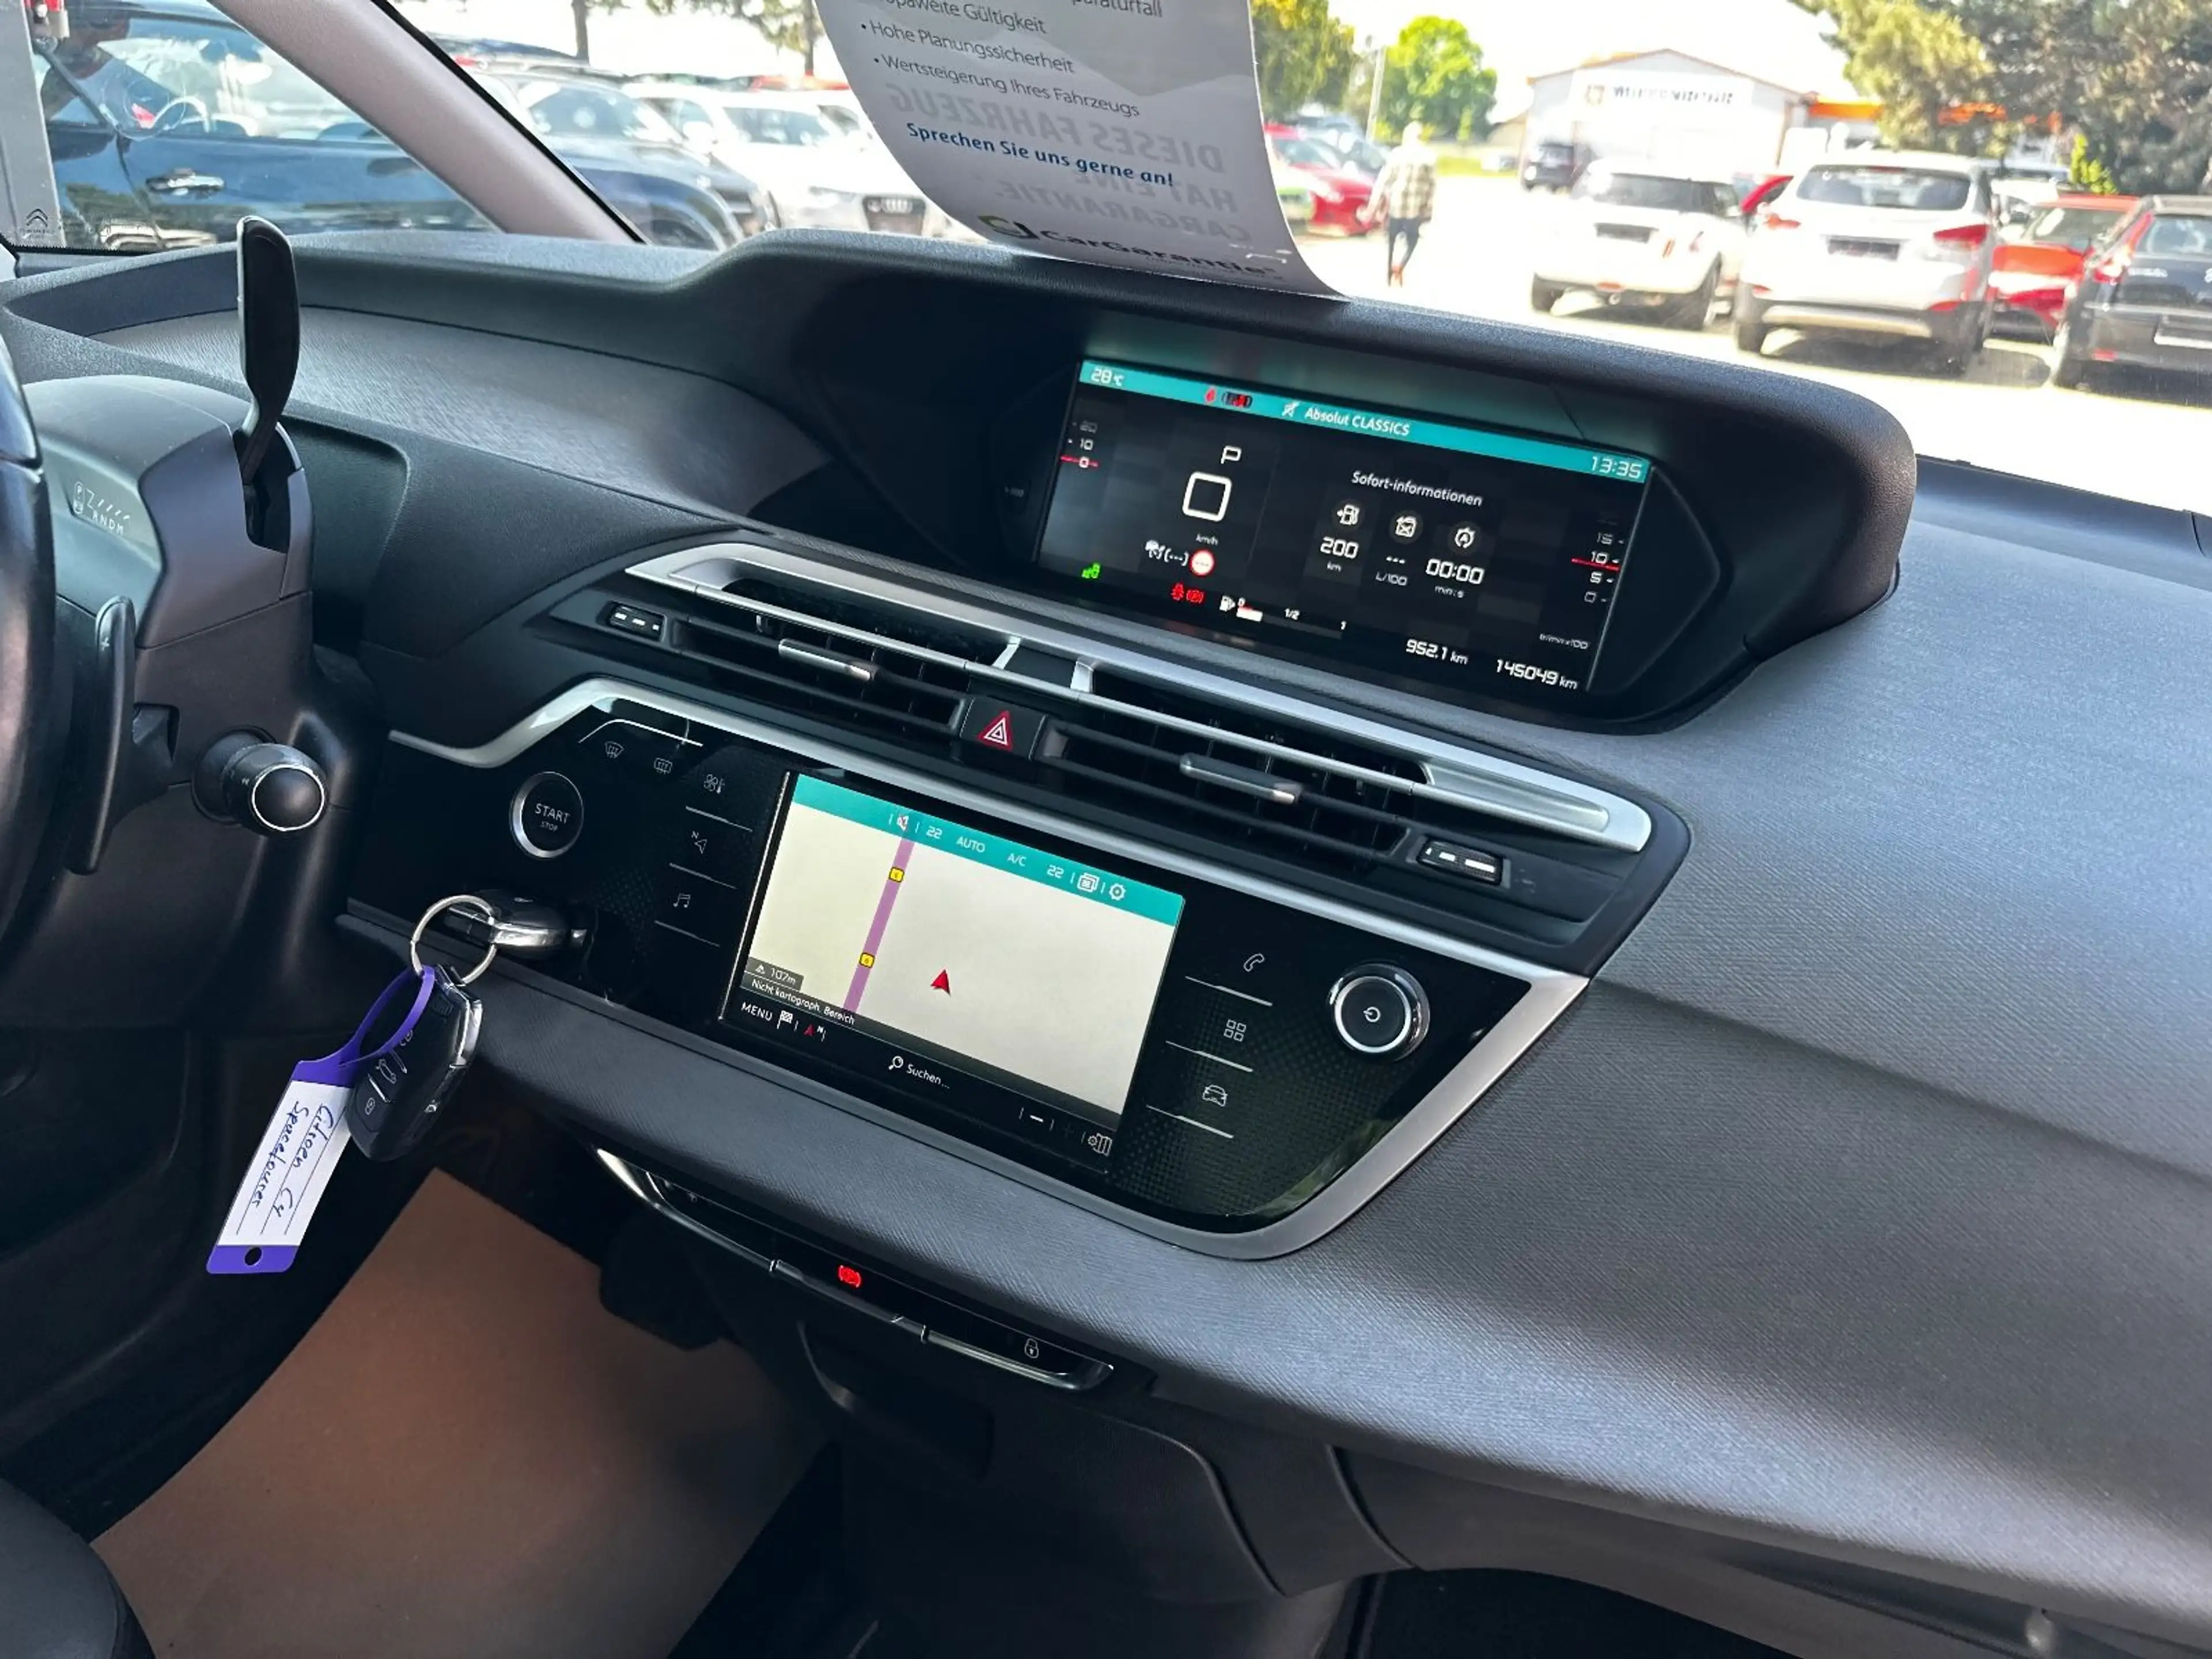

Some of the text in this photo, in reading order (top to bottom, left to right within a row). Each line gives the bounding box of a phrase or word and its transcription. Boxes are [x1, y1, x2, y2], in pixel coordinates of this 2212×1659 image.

[963, 3, 1047, 34] Gültigkeit
[870, 20, 1074, 73] Hohe Planungssicherheit
[881, 54, 1140, 118] Wertsteigerung Ihres Fahrzeugs
[907, 122, 1173, 187] Sprechen Sie uns gerne an!
[1304, 407, 1410, 436] Absolut CLASSICS
[1080, 438, 1094, 451] 10
[1221, 445, 1242, 464] P
[1591, 455, 1642, 479] 13:35
[1351, 470, 1483, 507] Sofort-informationen
[1320, 536, 1359, 559] 200
[1591, 551, 1609, 565] 10
[1327, 560, 1342, 573] km
[1425, 558, 1485, 585] 00:00
[1589, 571, 1603, 584] 5
[1584, 591, 1597, 604] 0
[1284, 608, 1300, 621] 1/2
[1406, 638, 1469, 665] 952.1 km
[1496, 658, 1578, 690] 145049 km
[535, 802, 571, 824] START
[926, 825, 943, 839] 22
[956, 836, 986, 853] AUTO
[1007, 853, 1027, 867] A/C
[1046, 864, 1065, 879] 22
[741, 1001, 773, 1021] MENU
[752, 979, 774, 995] Nicht
[823, 1006, 855, 1025] Bereich
